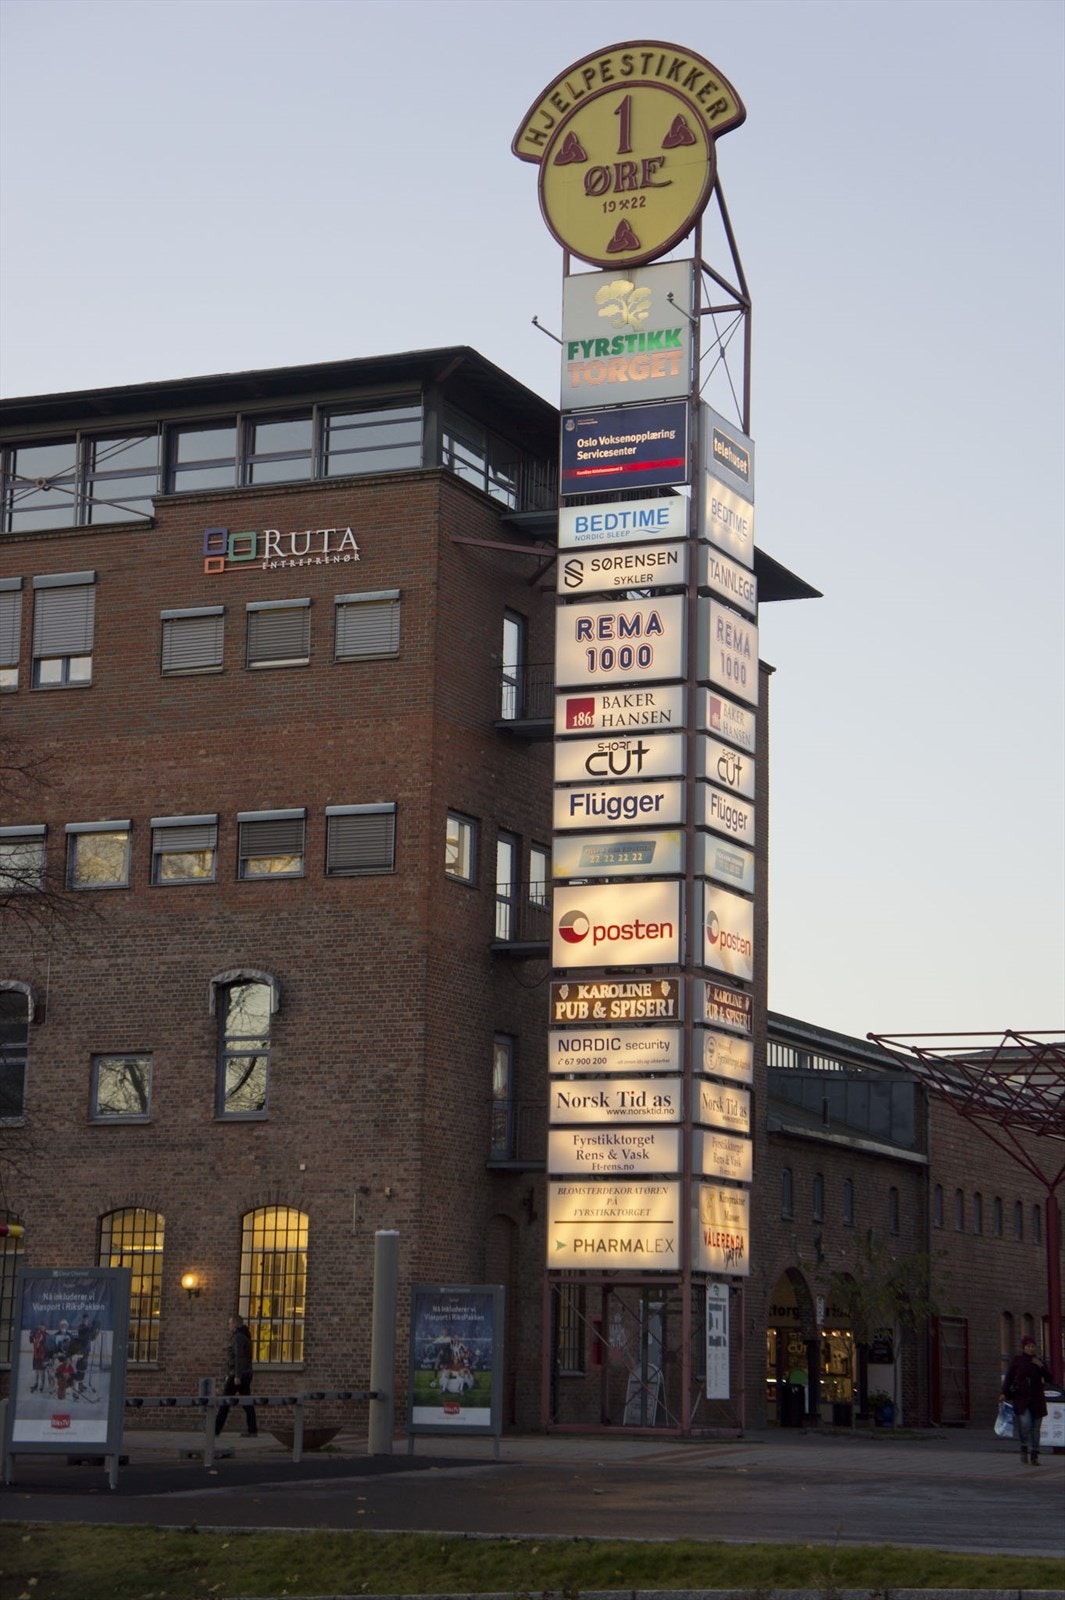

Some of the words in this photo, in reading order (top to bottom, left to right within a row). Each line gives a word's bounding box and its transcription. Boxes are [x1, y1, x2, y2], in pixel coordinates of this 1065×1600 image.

[524, 52, 729, 147] HJELPESTIKKER
[614, 94, 632, 155] 1
[584, 155, 673, 197] ØRE
[630, 195, 646, 209] 22
[567, 327, 682, 361] FYRSTIKK
[567, 349, 684, 389] TORGET
[577, 437, 598, 448] Oslo
[598, 429, 676, 446] Voksenopplæring
[576, 446, 637, 460] Servicesenter
[713, 436, 748, 475] telehuset
[575, 507, 669, 533] BEDTIME
[710, 497, 749, 538] BEDTIME
[263, 526, 360, 559] RUTA
[574, 531, 604, 542] NORDIC
[607, 530, 630, 539] SLEEP
[262, 553, 361, 570] ENTREPRENØR
[591, 551, 678, 572] SØRENSEN
[613, 573, 654, 586] SYKLER
[709, 556, 755, 605] TANNLEGE
[576, 611, 663, 641] REMA
[717, 614, 751, 659] REMA
[586, 643, 653, 673] 1000
[720, 651, 747, 688] 1000
[602, 692, 656, 709] BAKER
[602, 709, 672, 727] HANSEN
[723, 703, 745, 726] BAKER
[723, 722, 751, 746] HANSEN
[569, 792, 664, 821] Flügger
[711, 793, 748, 832] Flügger
[604, 854, 615, 863] 22
[618, 853, 629, 862] 22
[632, 852, 643, 861] 22
[593, 919, 673, 946] posten
[719, 930, 751, 957] posten
[578, 983, 652, 1000] KAROLINE
[713, 988, 743, 1008] KAROLINE
[555, 1001, 589, 1020] PUB
[592, 1002, 607, 1018] &
[610, 998, 674, 1018] SPISERI
[557, 1038, 621, 1053] NORDIC
[625, 1039, 670, 1052] security
[557, 1092, 610, 1109] Norsk
[616, 1091, 646, 1108] Tid
[653, 1095, 671, 1107] as
[702, 1092, 724, 1113] Norsk
[726, 1098, 738, 1116] Tid
[739, 1105, 747, 1118] as
[606, 1107, 675, 1115] www.norsktid.no
[573, 1133, 655, 1148] Fyrstikktorget
[576, 1150, 604, 1161] Rens
[607, 1149, 618, 1160] &
[622, 1148, 650, 1160] Vask
[592, 1162, 635, 1172] Ft-rens.no
[557, 1186, 669, 1196] BLOMSTERDEKORATØREN
[606, 1196, 618, 1206] PÅ
[573, 1208, 652, 1217] FYRSTIKKTORGET
[573, 1238, 675, 1254] PHARMALEX
[703, 1227, 744, 1252] VÅLERENGA
[42, 1292, 53, 1300] Nå
[65, 1302, 105, 1311] RiksPakken
